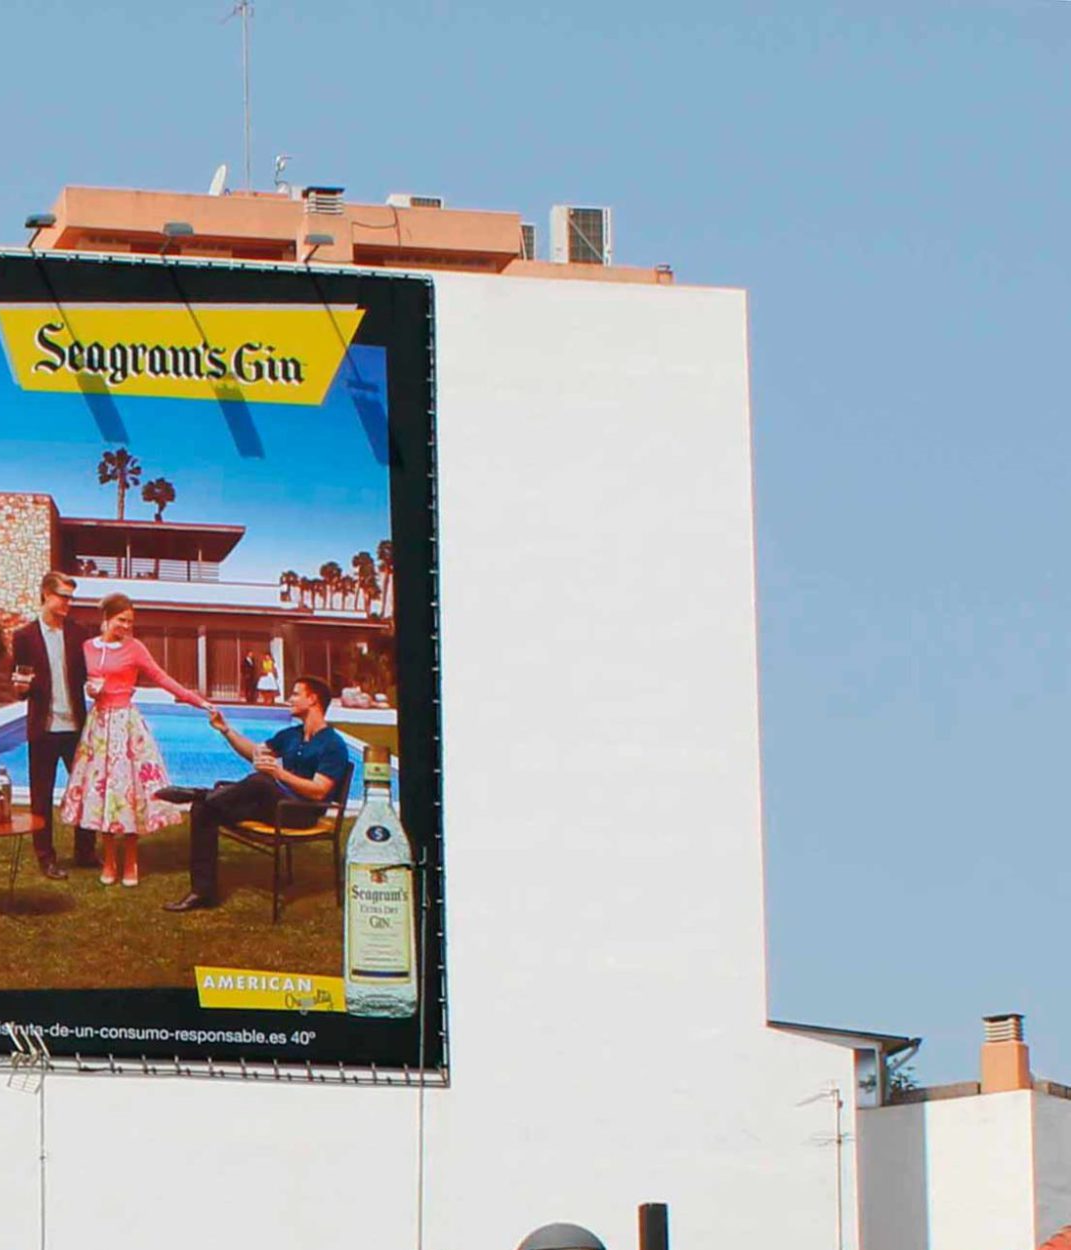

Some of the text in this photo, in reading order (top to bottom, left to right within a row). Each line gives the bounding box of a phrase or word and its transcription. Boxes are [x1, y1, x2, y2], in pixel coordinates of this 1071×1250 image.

[31, 322, 305, 385] Seagram's Gin
[351, 884, 409, 904] Seagram's
[203, 974, 313, 993] AMERICAN
